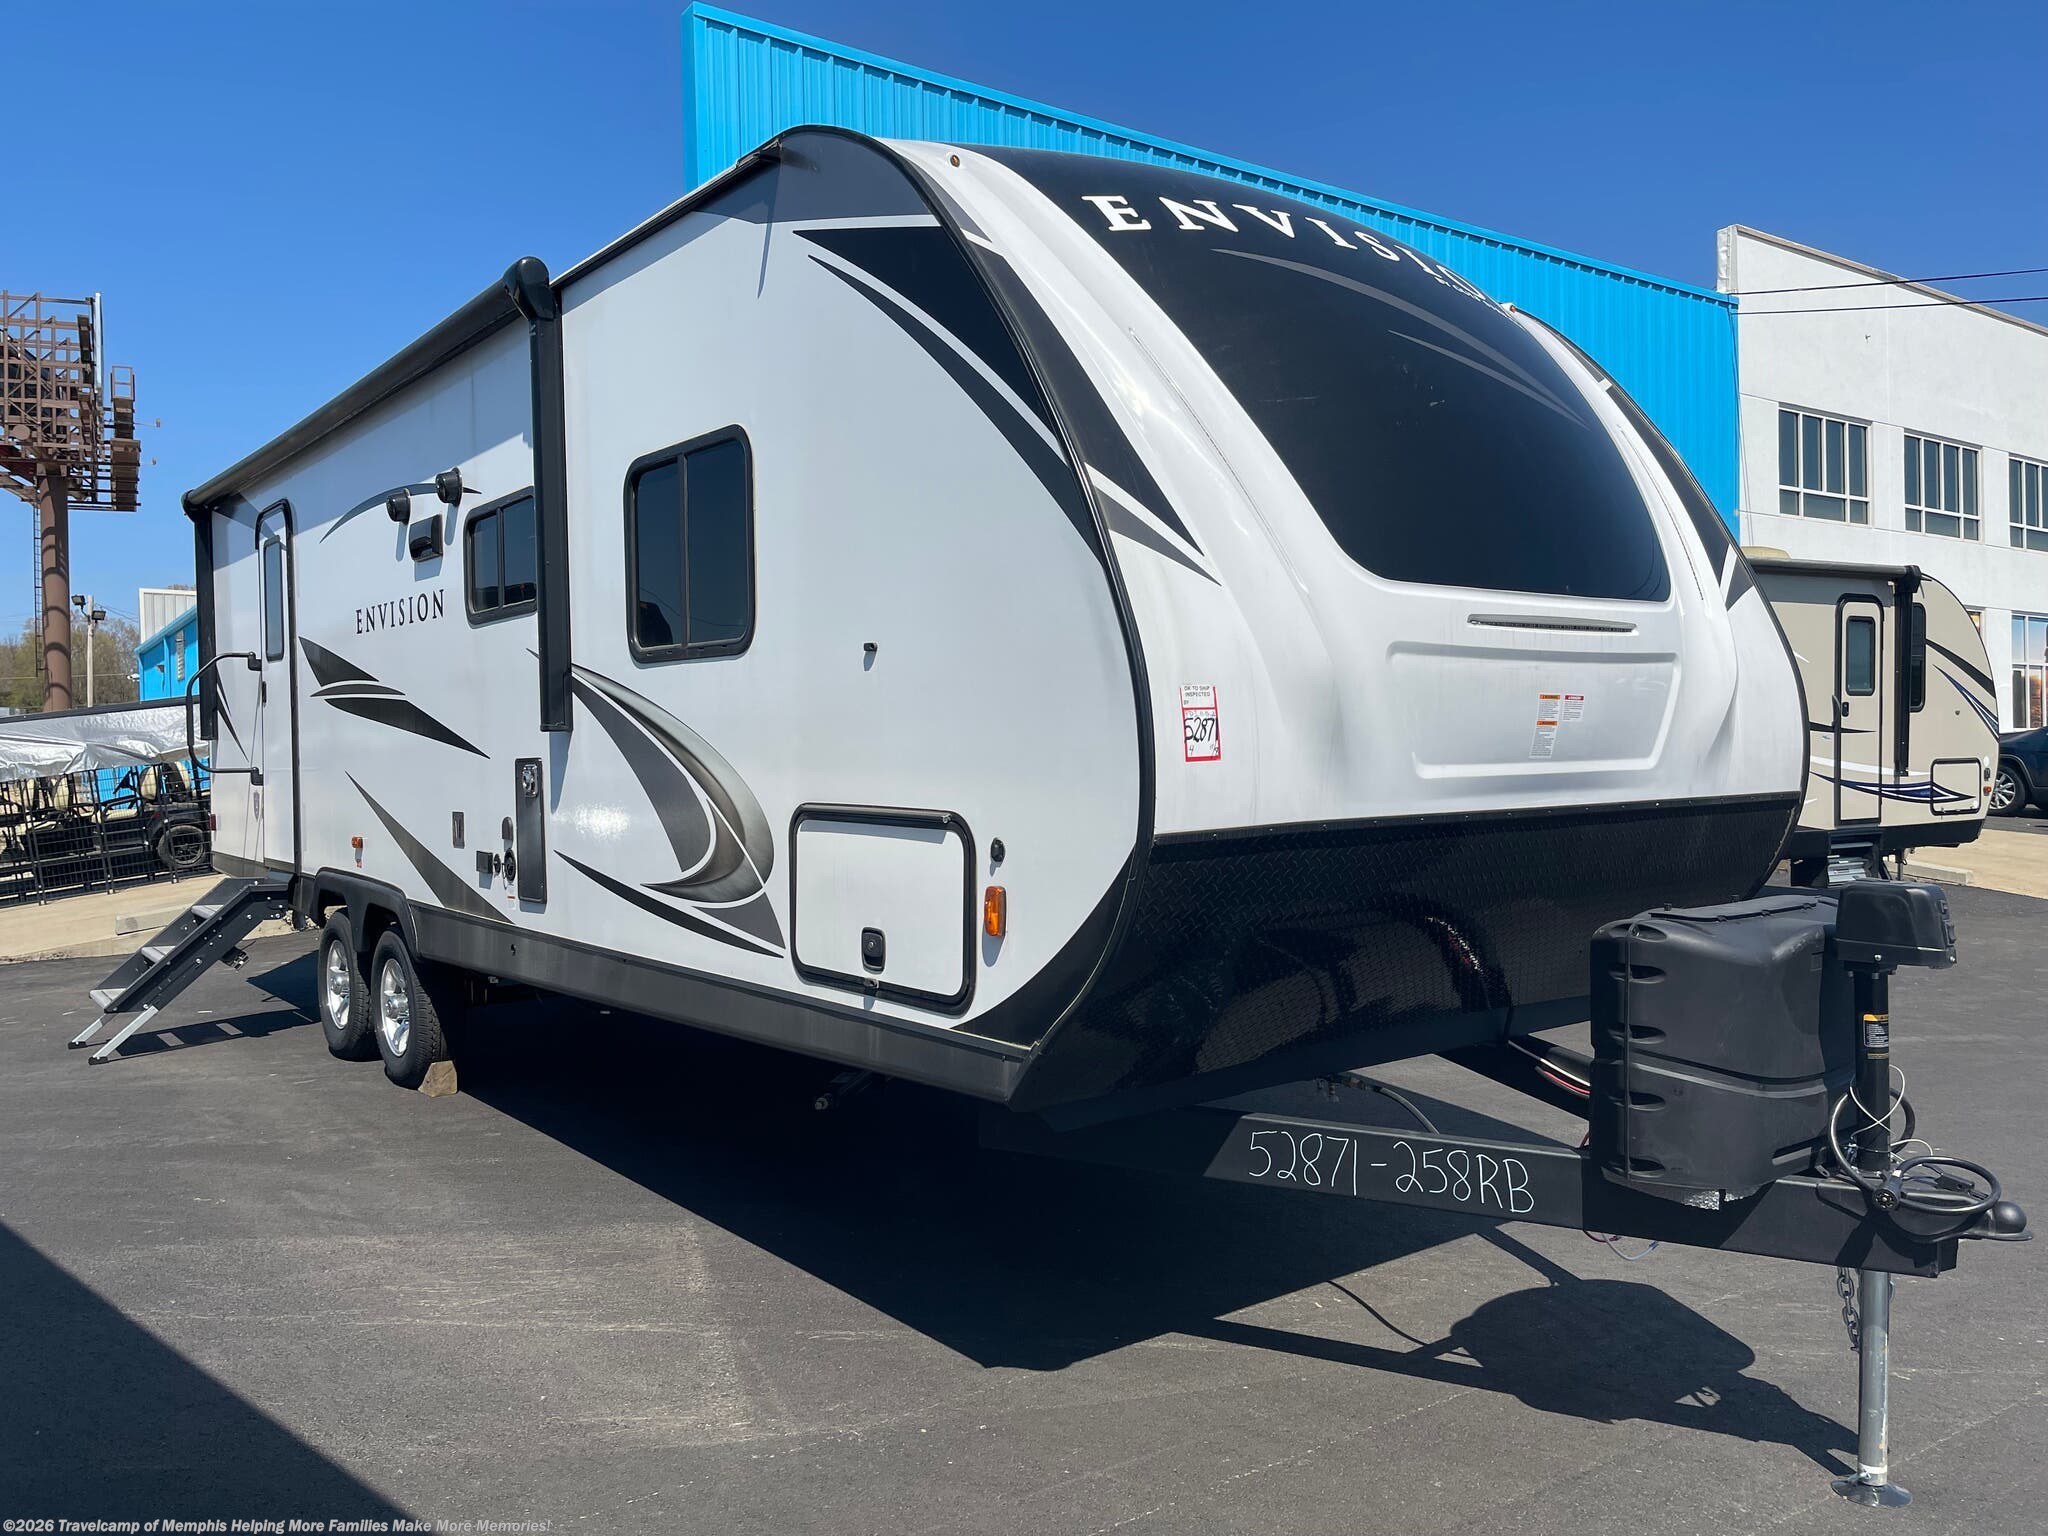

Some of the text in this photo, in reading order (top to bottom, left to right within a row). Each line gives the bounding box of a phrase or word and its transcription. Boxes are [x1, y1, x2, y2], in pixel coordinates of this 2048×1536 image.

[1081, 195, 1487, 301] ENVISIO
[356, 588, 445, 635] ENVISION
[1249, 1130, 1535, 1214] 52871-258RB
